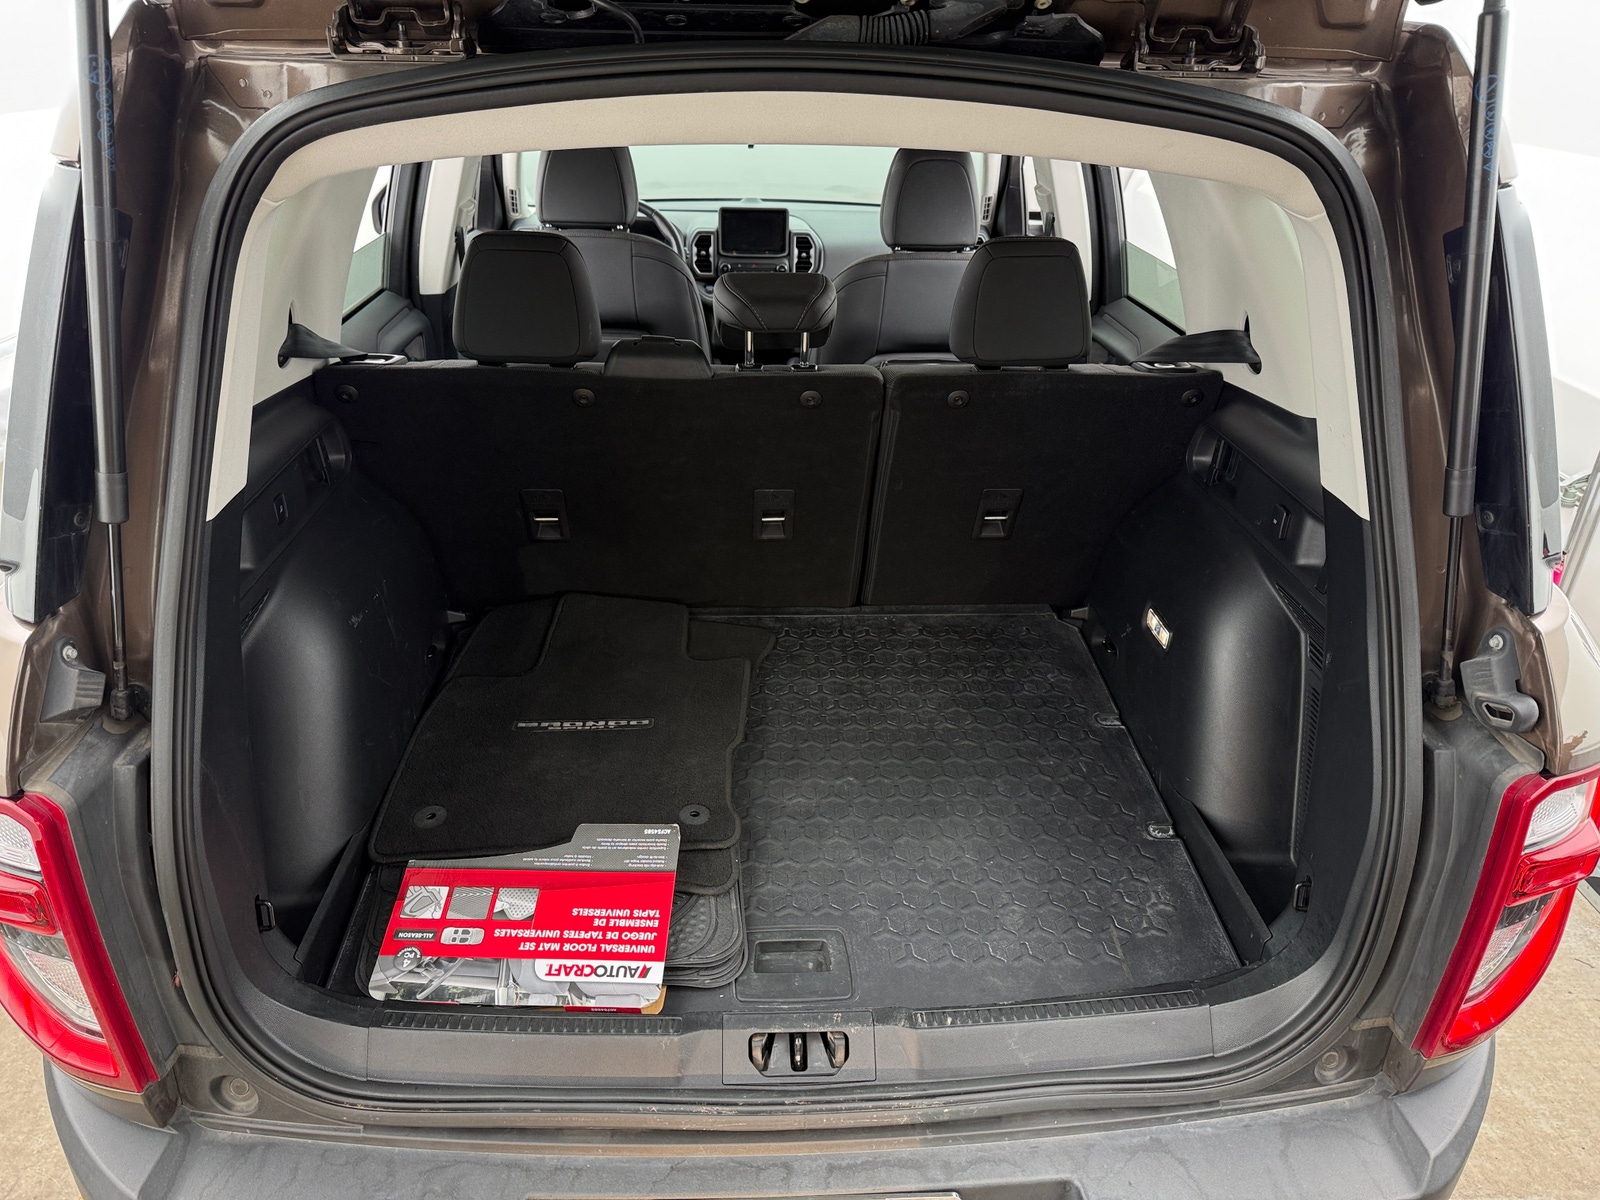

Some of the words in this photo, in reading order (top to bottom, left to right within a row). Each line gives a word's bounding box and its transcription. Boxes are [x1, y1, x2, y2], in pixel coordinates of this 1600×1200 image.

[572, 908, 630, 917] UNIVERSELS
[632, 909, 660, 918] TAPIS
[593, 918, 606, 926] DE
[609, 919, 659, 928] ENSEMBLE
[493, 929, 560, 938] UNIVERSALES
[562, 930, 603, 939] TAPETES
[605, 931, 619, 940] DE
[622, 932, 658, 940] JUEGO
[518, 942, 536, 950] SET
[539, 942, 560, 951] MAT
[562, 943, 597, 952] FLOOR
[600, 944, 655, 953] UNIVERSAL
[402, 959, 411, 968] 4
[545, 964, 640, 979] AUTOCRAFT
